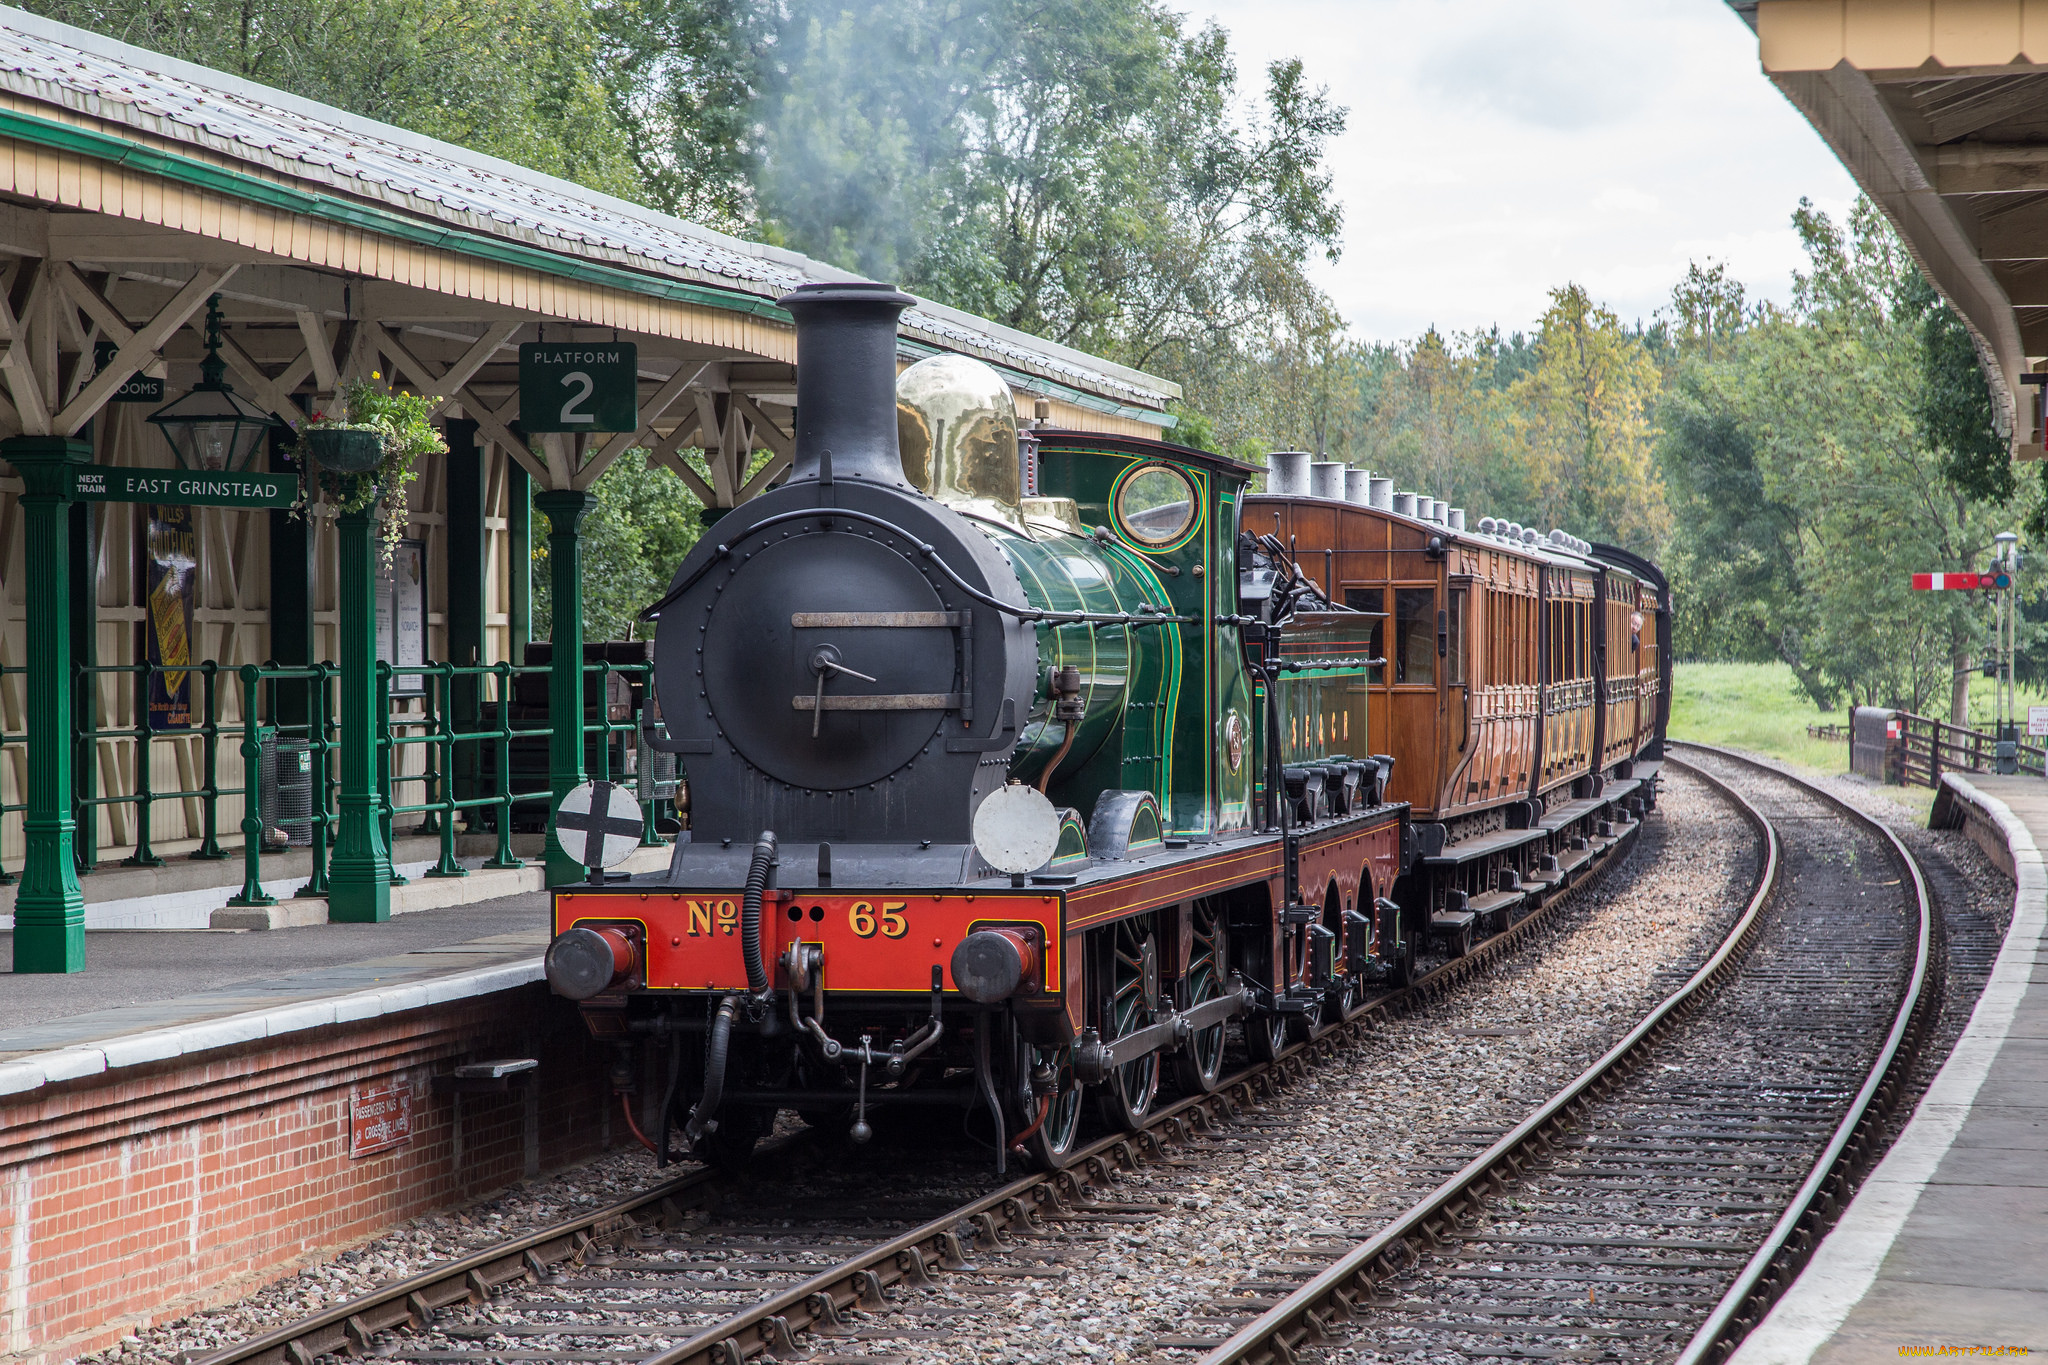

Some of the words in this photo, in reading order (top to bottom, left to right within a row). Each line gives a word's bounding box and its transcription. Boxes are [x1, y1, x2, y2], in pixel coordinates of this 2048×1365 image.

[534, 352, 619, 364] PLATFORM
[560, 371, 594, 423] 2
[78, 474, 104, 483] NEXT
[76, 484, 106, 494] TRAIN
[126, 478, 172, 493] EAST
[178, 480, 278, 498] GRINSTEAD
[848, 901, 908, 938] 65
[355, 1102, 385, 1120] PASSENGERS
